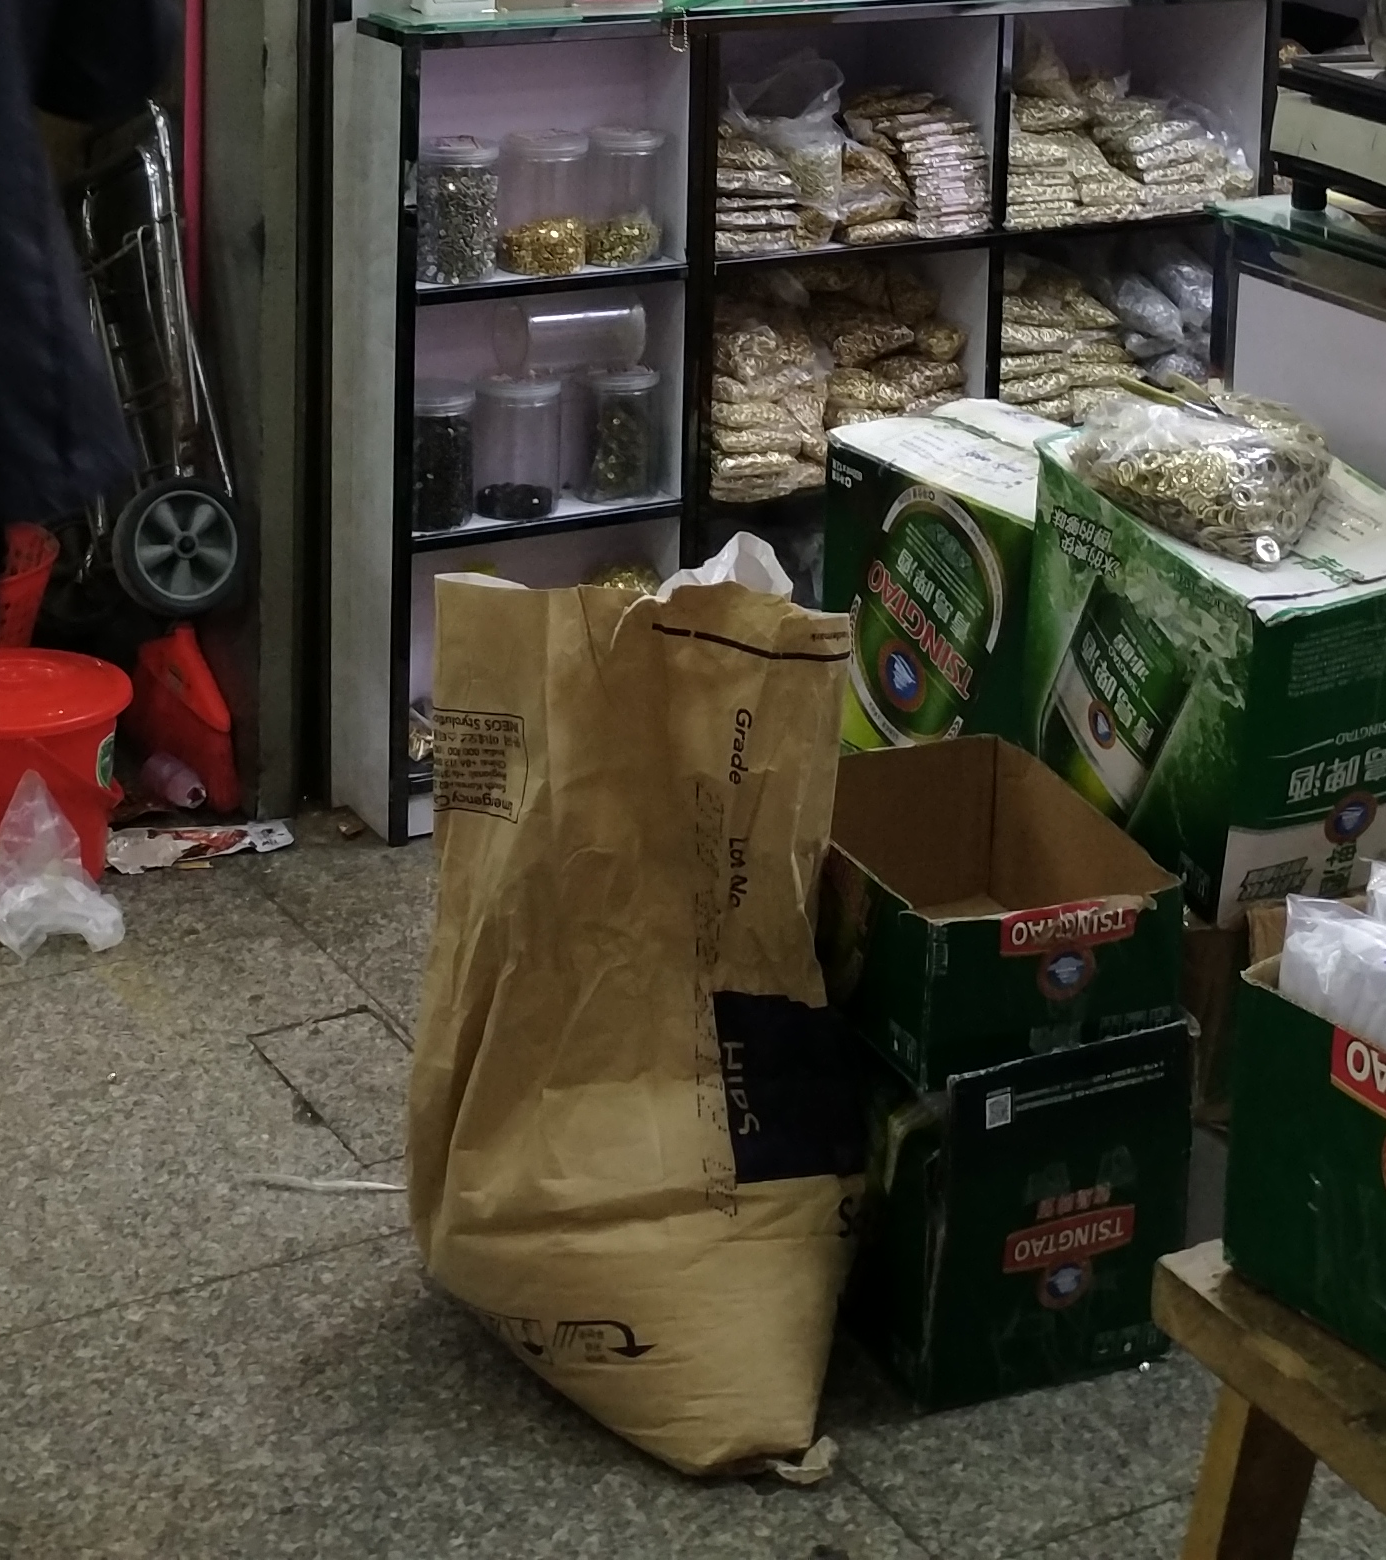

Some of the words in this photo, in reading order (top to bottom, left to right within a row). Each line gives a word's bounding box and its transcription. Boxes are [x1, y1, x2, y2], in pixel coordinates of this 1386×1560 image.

[866, 558, 974, 701] TSINGTAO
[1106, 644, 1140, 698] TSINGTAO
[728, 707, 753, 786] Grade
[1011, 905, 1126, 947] TSINGTAO
[1013, 1215, 1124, 1262] TSINGTAO
